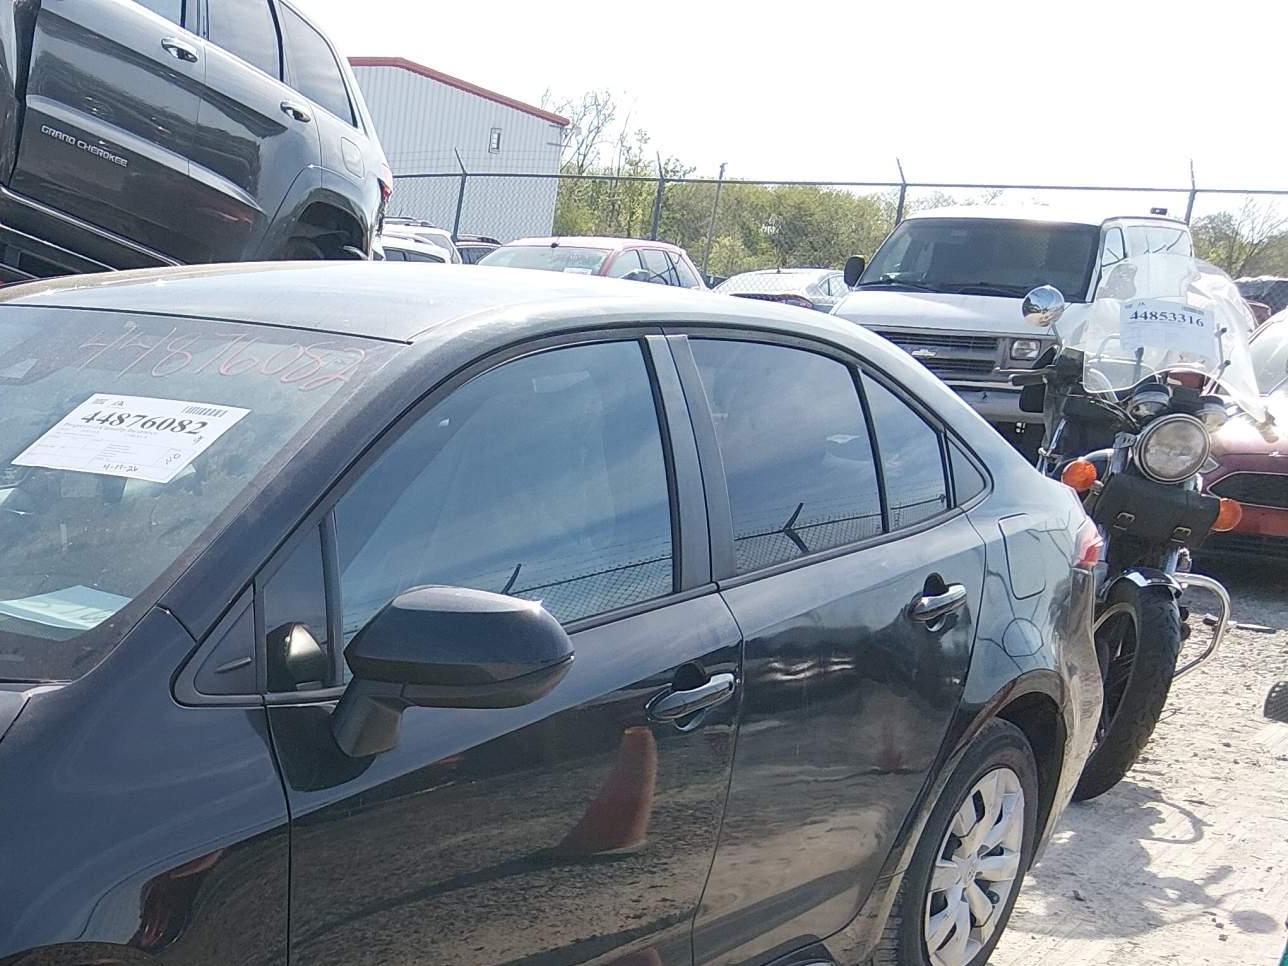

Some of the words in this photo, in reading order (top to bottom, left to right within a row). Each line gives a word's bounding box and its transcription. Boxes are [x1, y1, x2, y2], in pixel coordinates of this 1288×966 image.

[41, 125, 75, 145] GRAND
[77, 141, 128, 167] CHEROKEE
[1130, 310, 1203, 327] 44853316
[78, 327, 367, 390] 44876082
[80, 410, 209, 436] 44876082
